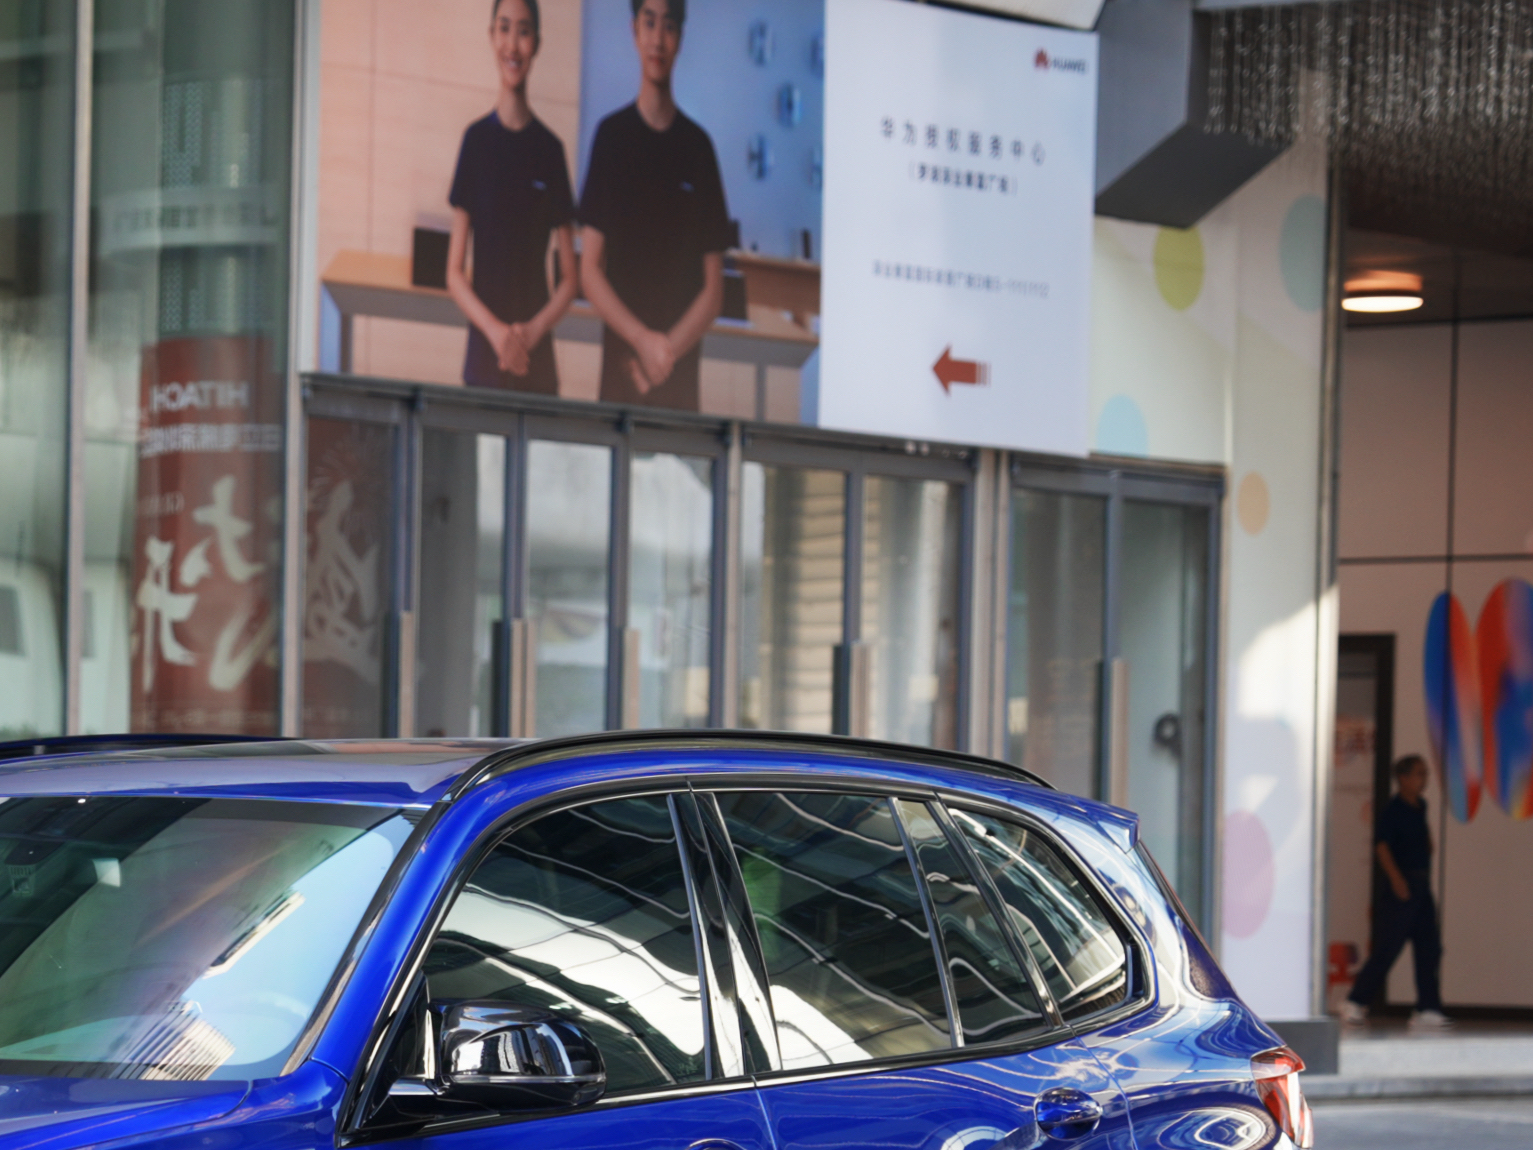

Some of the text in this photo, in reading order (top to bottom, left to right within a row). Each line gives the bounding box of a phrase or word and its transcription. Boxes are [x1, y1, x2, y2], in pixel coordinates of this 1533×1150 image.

[881, 115, 1046, 167] 华为授权服务中心
